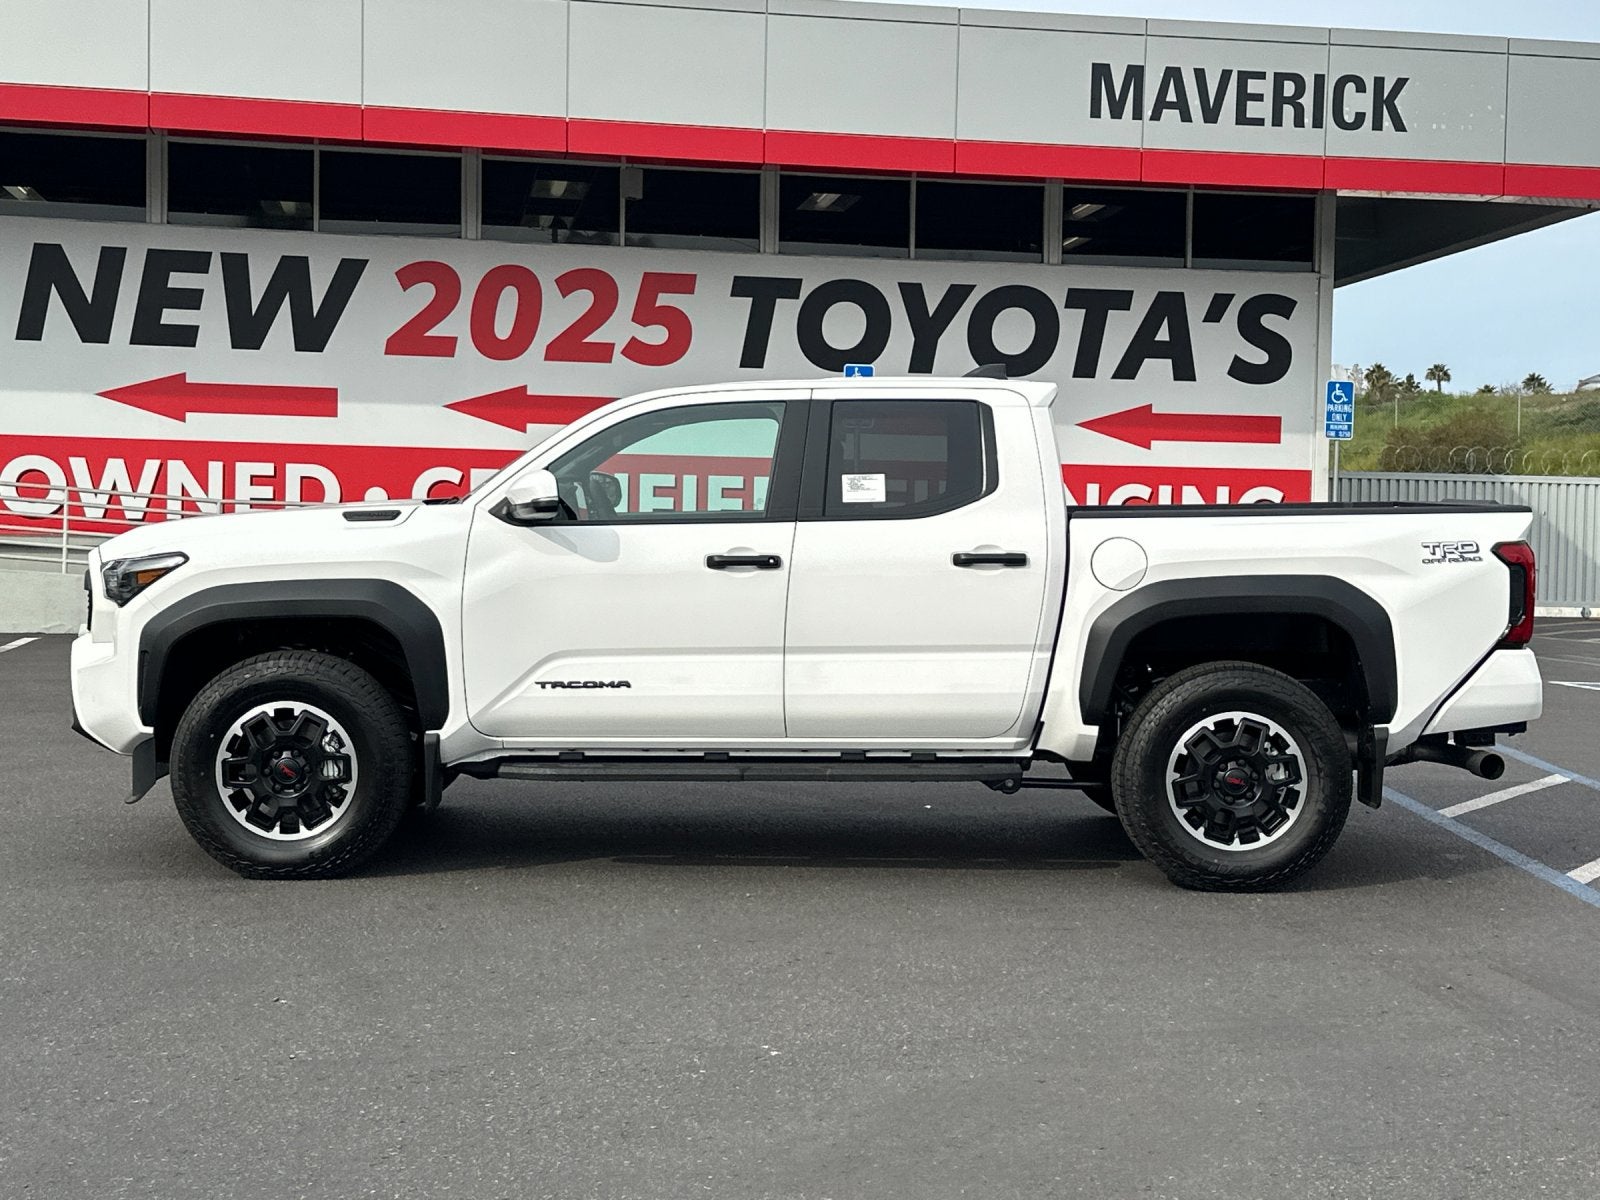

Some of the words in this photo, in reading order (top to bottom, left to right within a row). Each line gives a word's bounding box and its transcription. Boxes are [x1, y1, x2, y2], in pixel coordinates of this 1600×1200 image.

[1089, 62, 1410, 132] MAVERICK
[15, 242, 369, 353] NEW
[384, 260, 697, 367] 2025
[730, 275, 1298, 385] TOYOTA'S
[1327, 403, 1352, 413] PARKING
[1331, 412, 1348, 421] ONLY
[1421, 541, 1480, 559] TRD
[535, 680, 632, 689] TACOMA
